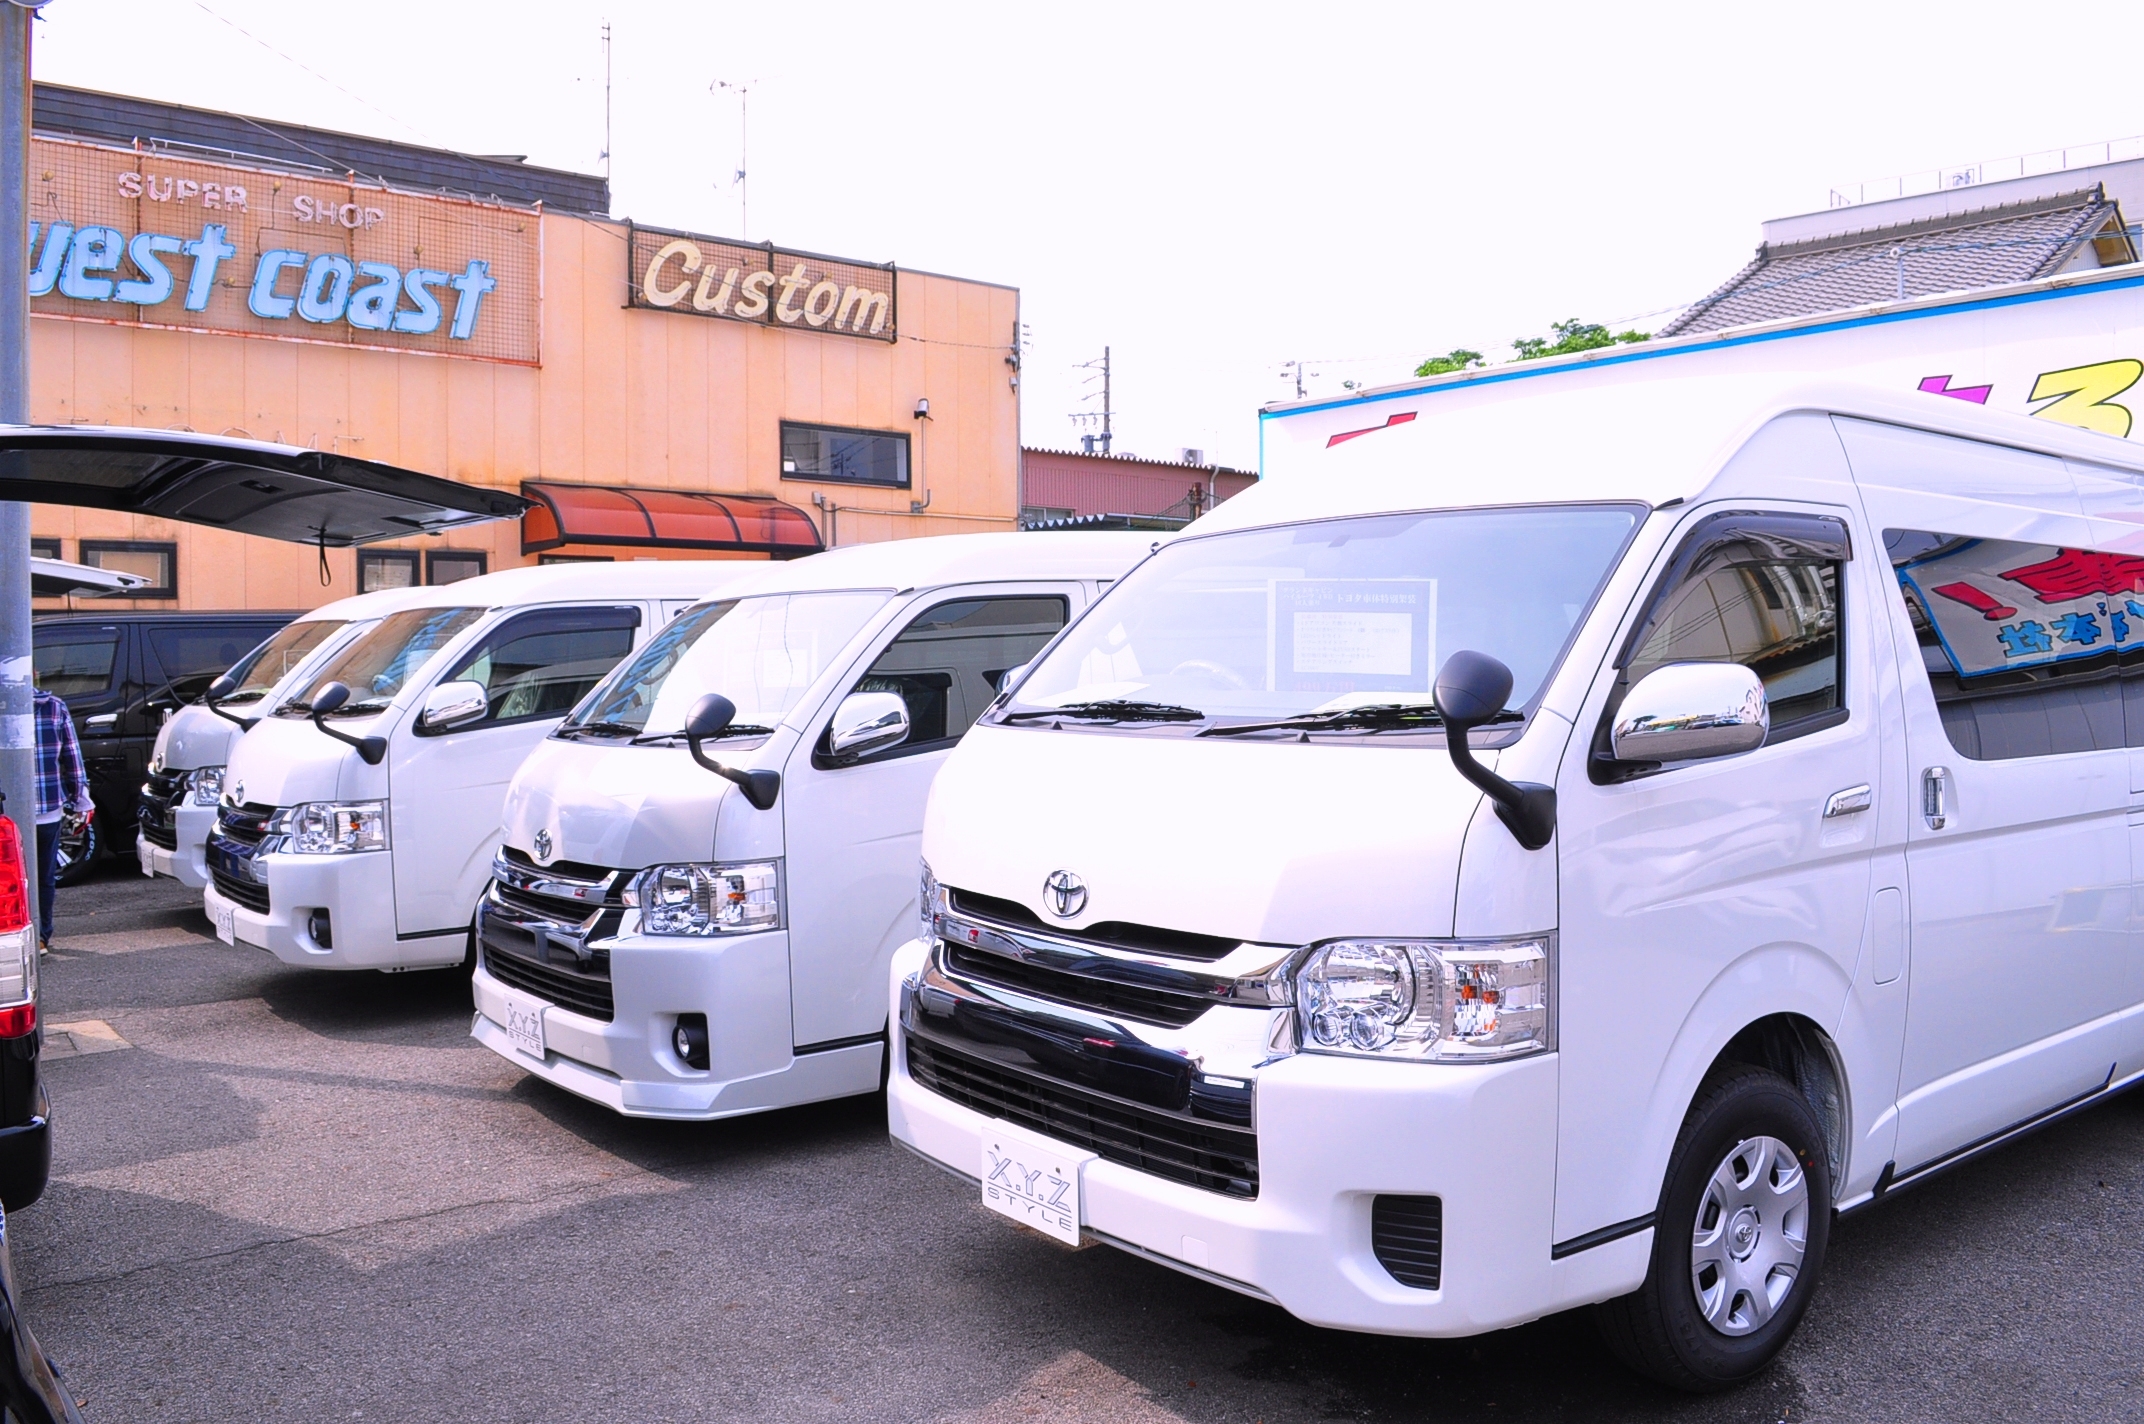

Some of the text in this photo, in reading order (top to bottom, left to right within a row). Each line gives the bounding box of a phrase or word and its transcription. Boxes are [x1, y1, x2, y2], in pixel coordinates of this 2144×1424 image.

[118, 172, 385, 231] SUPER SHOP
[248, 248, 497, 340] coast
[644, 240, 889, 334] Custom
[987, 1187, 1072, 1232] STYLE
